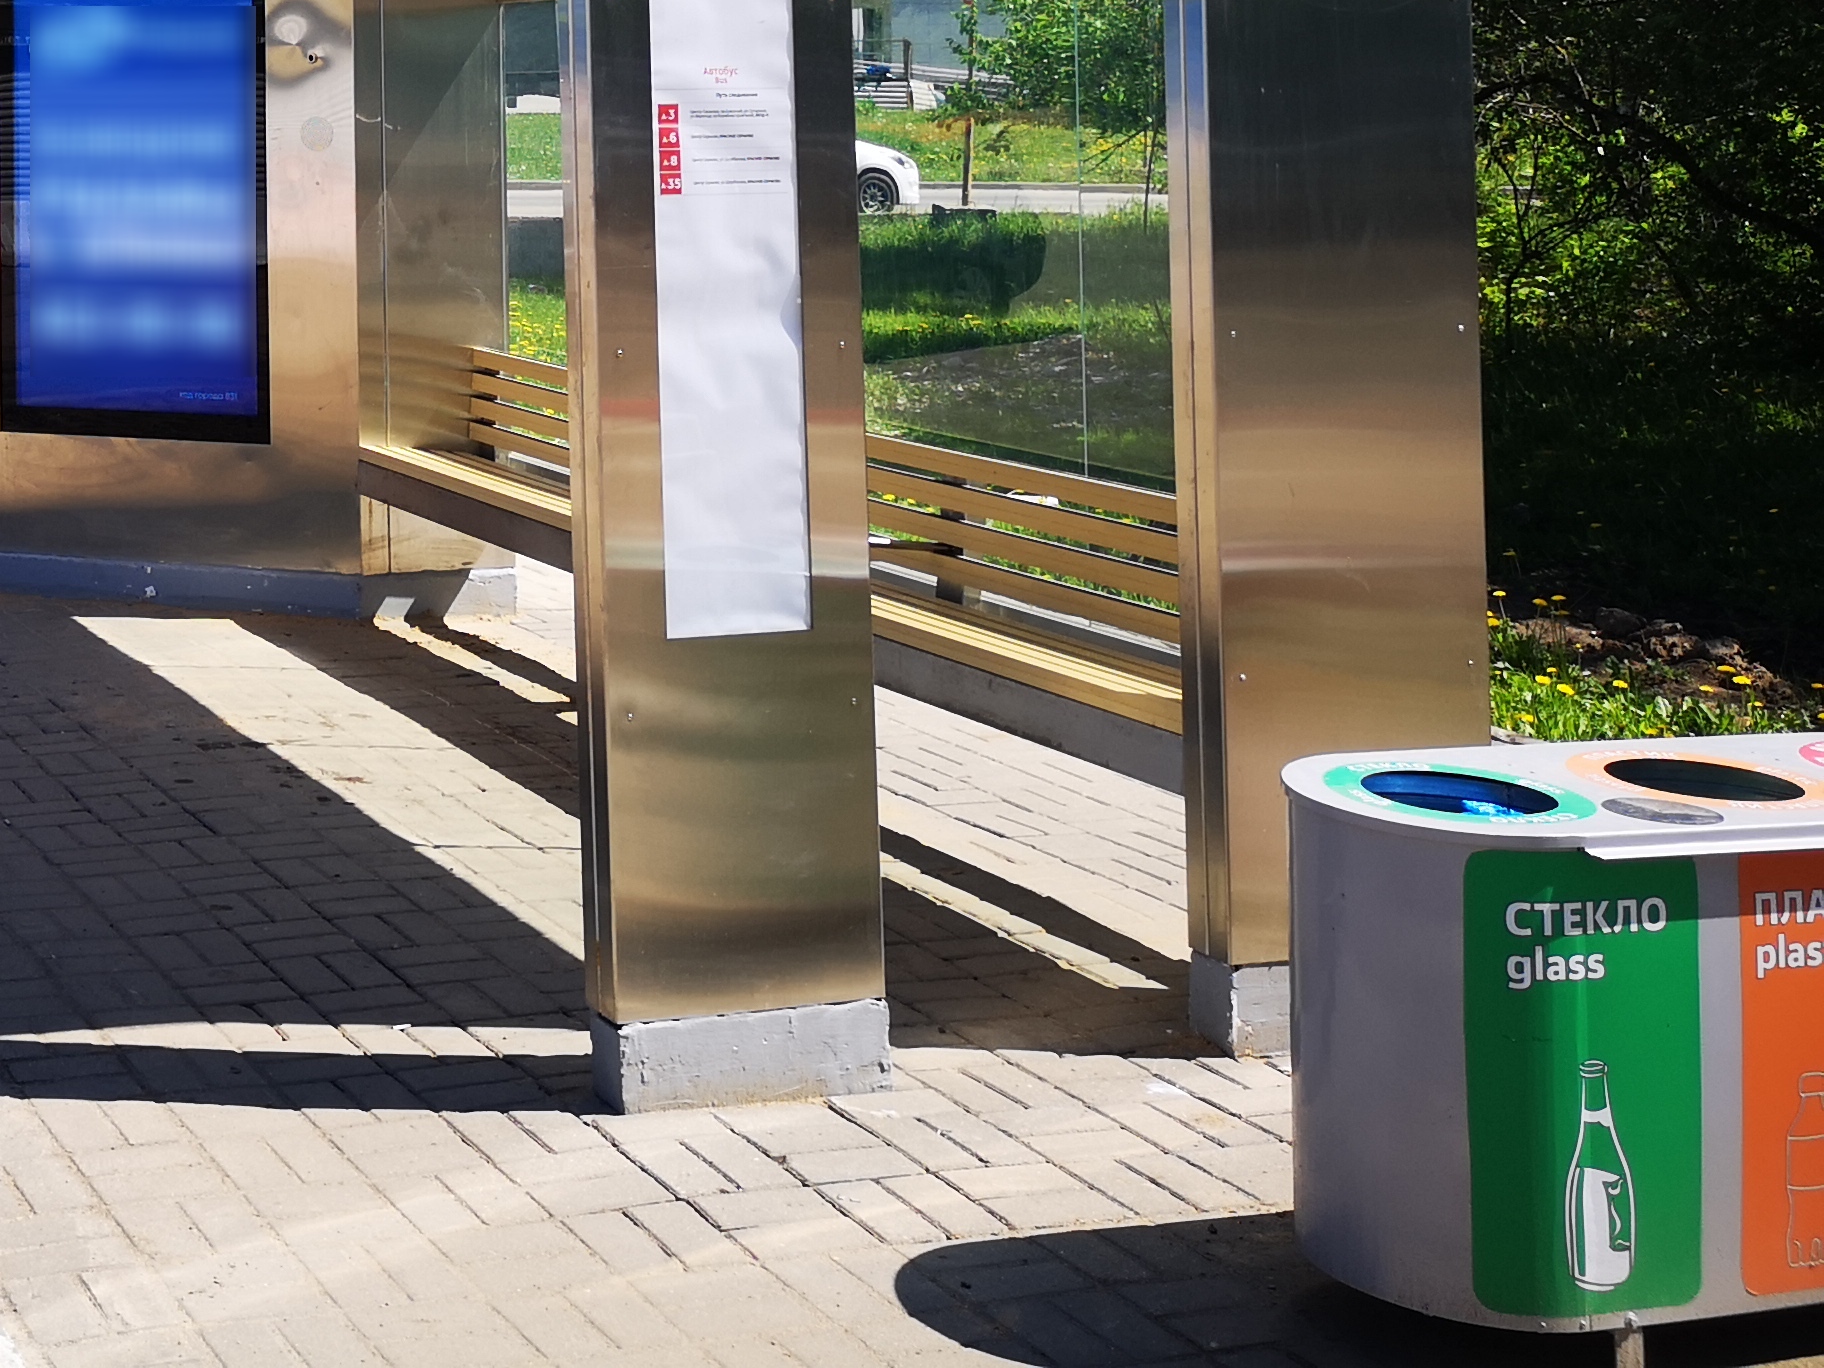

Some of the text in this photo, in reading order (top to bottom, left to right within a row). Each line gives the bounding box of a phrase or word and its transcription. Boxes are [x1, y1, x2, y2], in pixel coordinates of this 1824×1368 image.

[703, 66, 738, 77] Автобус
[1347, 761, 1431, 773] СТЕКЛО
[1505, 896, 1668, 937] СТЕКЛО
[1506, 946, 1605, 991] glass
